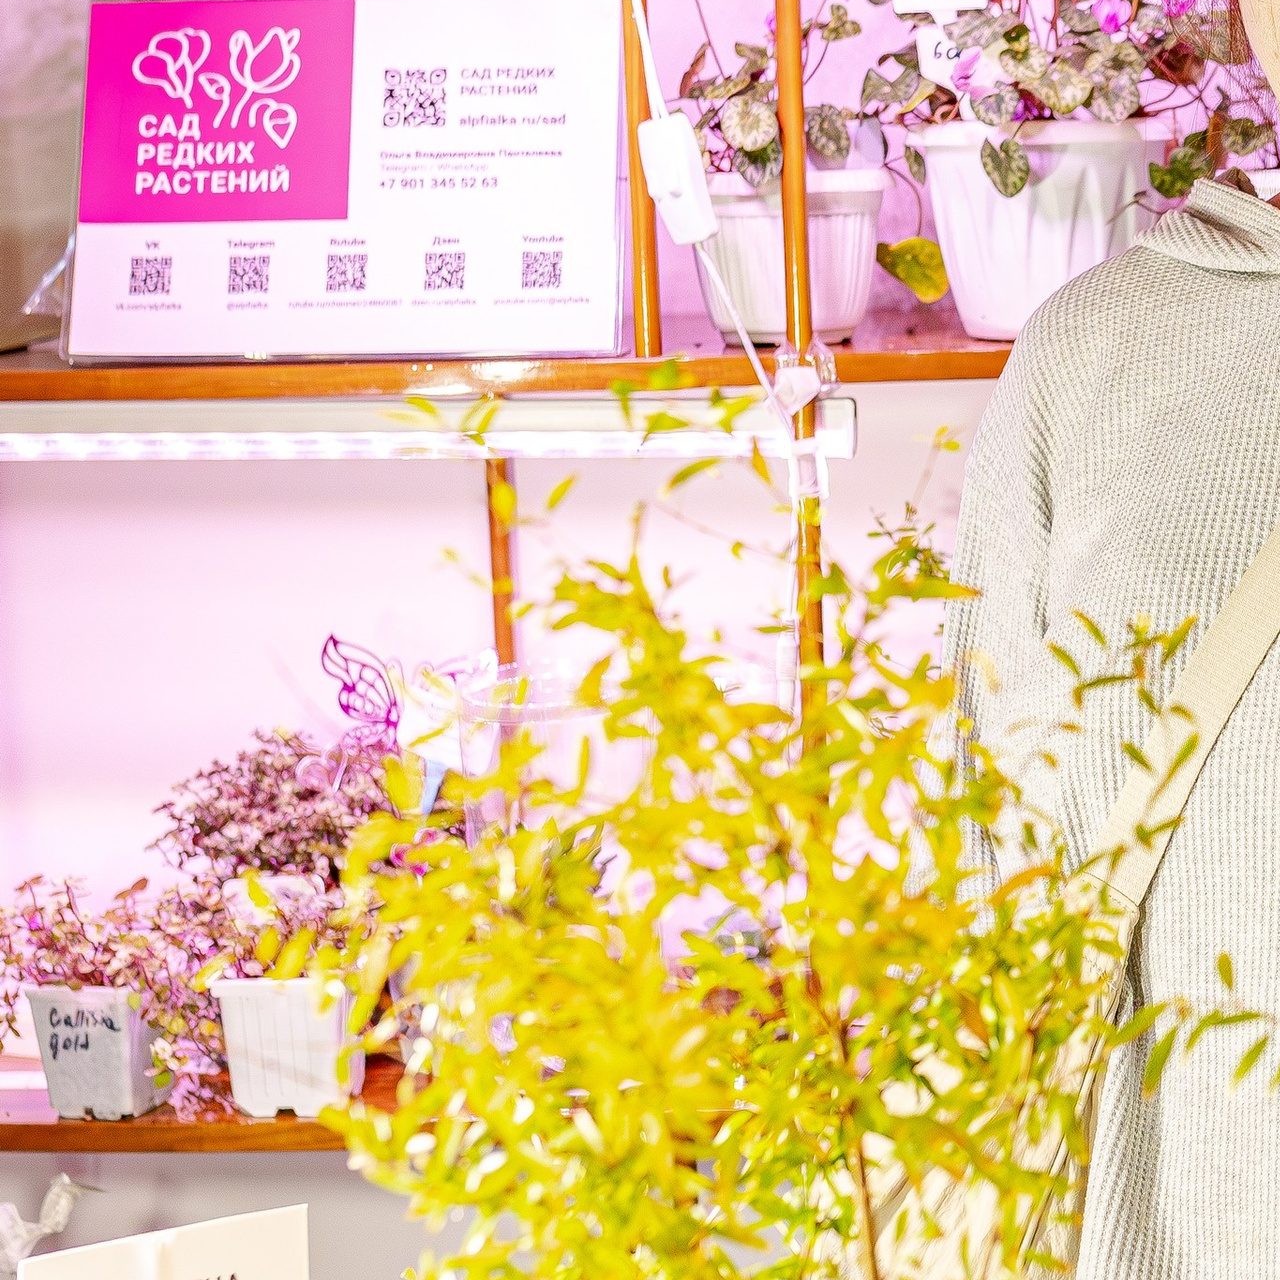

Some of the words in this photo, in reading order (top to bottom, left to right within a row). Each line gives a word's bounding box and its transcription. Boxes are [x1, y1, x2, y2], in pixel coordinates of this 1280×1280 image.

[460, 68, 492, 81] САД
[496, 66, 556, 80] РЕДКИХ
[460, 83, 538, 96] РАСТЕНИЙ
[138, 113, 201, 141] САД
[136, 141, 256, 170] РЕДКИХ
[135, 164, 290, 195] РАСТЕНИЙ
[379, 178, 395, 189] +7
[400, 178, 425, 189] 901
[430, 178, 456, 189] 345
[461, 177, 477, 189] 52
[481, 177, 498, 189] 63
[227, 239, 275, 250] Telegram
